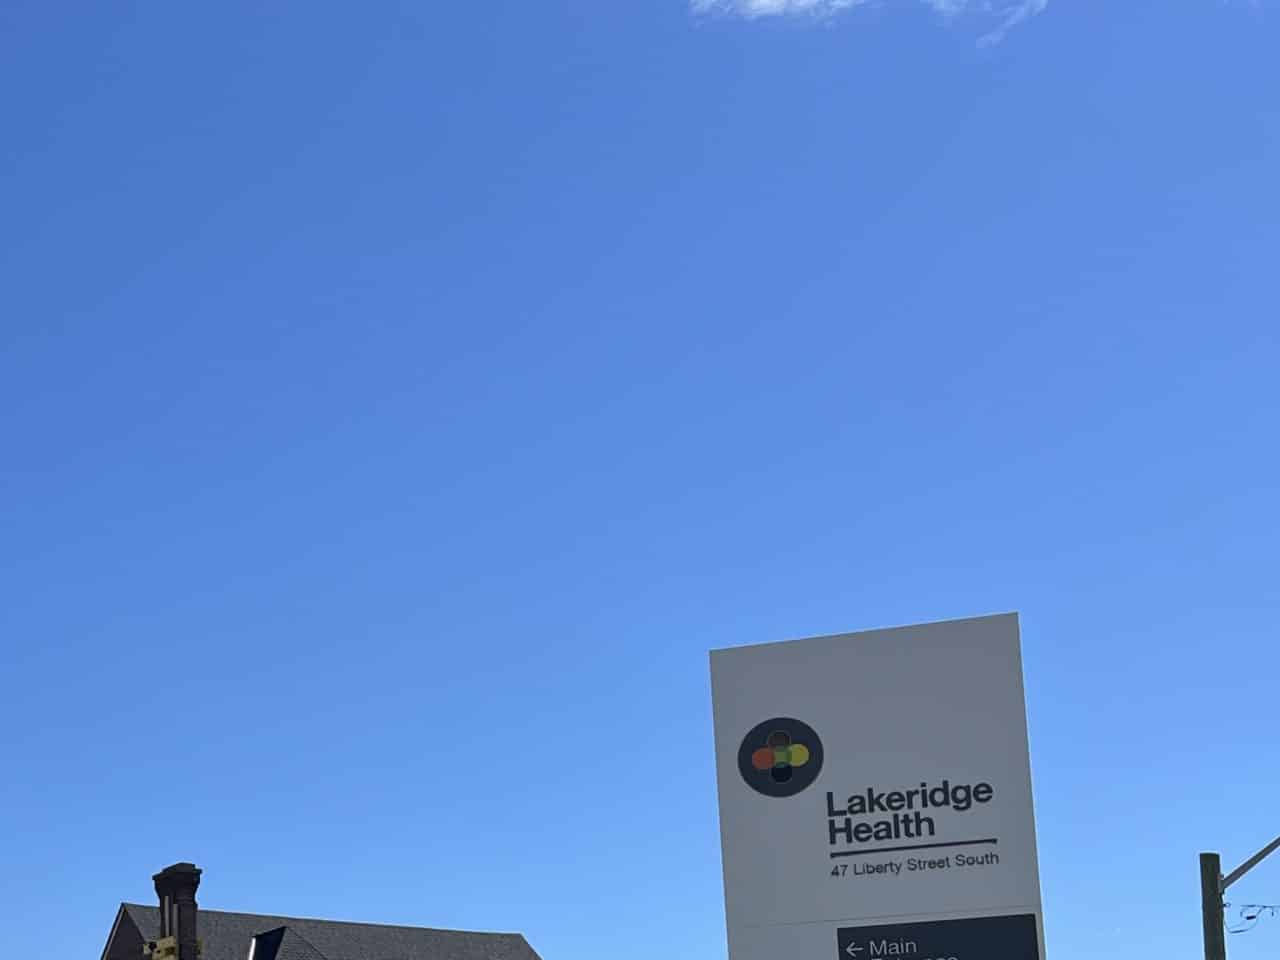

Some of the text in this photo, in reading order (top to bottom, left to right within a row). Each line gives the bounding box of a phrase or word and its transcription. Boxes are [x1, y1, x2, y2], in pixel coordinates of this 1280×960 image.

[826, 780, 993, 817] Lakeridge
[828, 811, 936, 845] Health
[830, 851, 1000, 877] 47 Liberty Street South
[869, 938, 918, 956] Main
